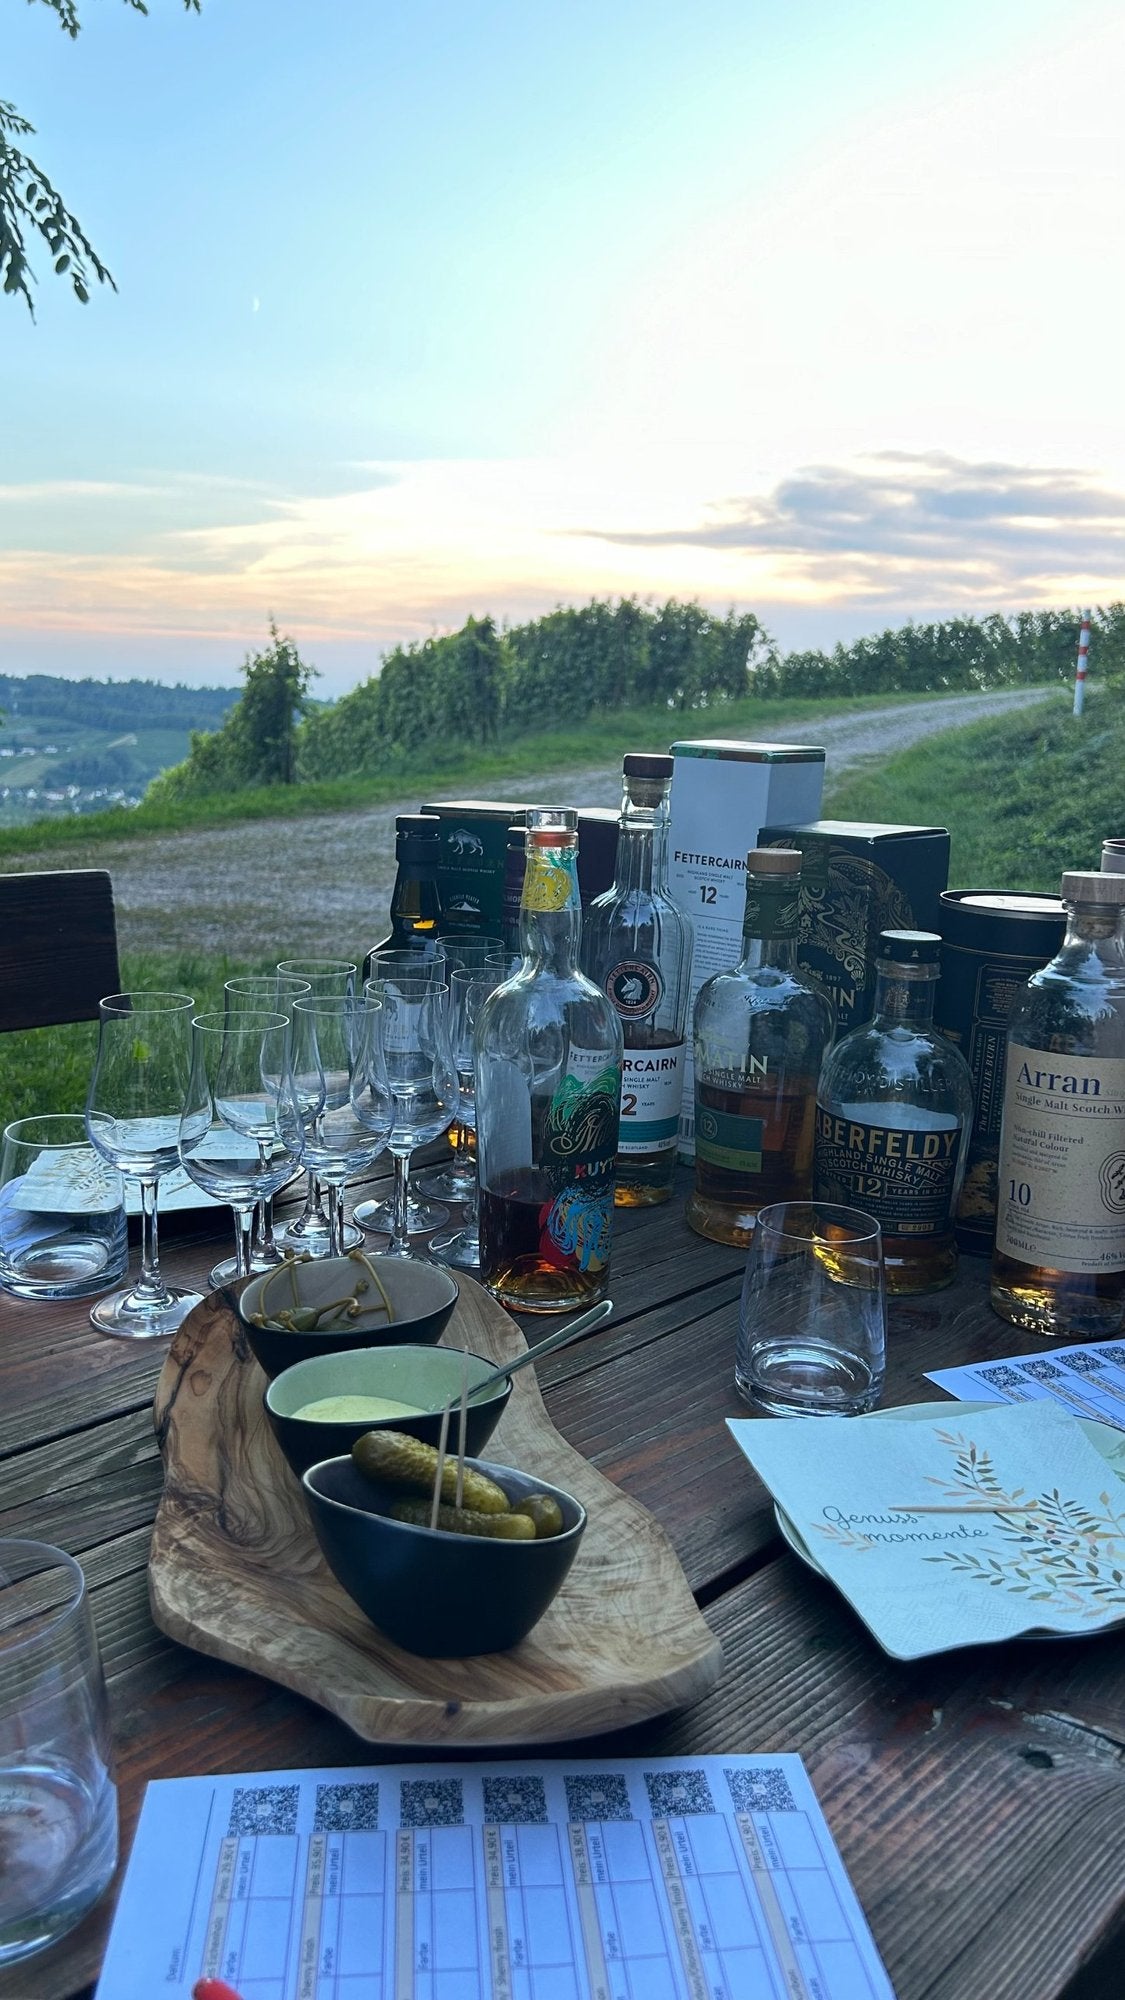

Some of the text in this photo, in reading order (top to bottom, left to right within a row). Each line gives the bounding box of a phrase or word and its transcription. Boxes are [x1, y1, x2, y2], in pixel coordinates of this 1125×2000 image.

[674, 851, 747, 870] FETTERCAIRN
[700, 885, 717, 904] 12
[694, 1043, 768, 1075] MATIN
[985, 1035, 996, 1066] BURN
[622, 1057, 677, 1072] RCAIRN
[708, 1069, 735, 1081] SINGLE
[738, 1075, 761, 1084] MALT
[711, 1077, 743, 1090] WHISKY
[1017, 1062, 1101, 1096] Arran
[621, 1094, 638, 1116] 2
[1016, 1092, 1041, 1106] Single
[1044, 1099, 1069, 1111] Malt
[1072, 1103, 1110, 1115] Scotch
[815, 1107, 958, 1159] ABERFELDY
[1014, 1134, 1069, 1153] Natural Colour
[1048, 1133, 1084, 1145] Filtered
[821, 1148, 941, 1182] GHLAND SINGLE MALT
[828, 1158, 920, 1185] SCOTCH WHISKY
[855, 1175, 881, 1198] 12
[892, 1188, 919, 1196] YEARS
[921, 1187, 930, 1195] IN
[1009, 1179, 1031, 1206] 10
[822, 1506, 925, 1531] Genuss-
[864, 1525, 989, 1543] momente
[504, 1840, 518, 1886] mein Urteil
[590, 1836, 606, 1881] mein Urteil
[674, 1831, 694, 1875] mein Urteil
